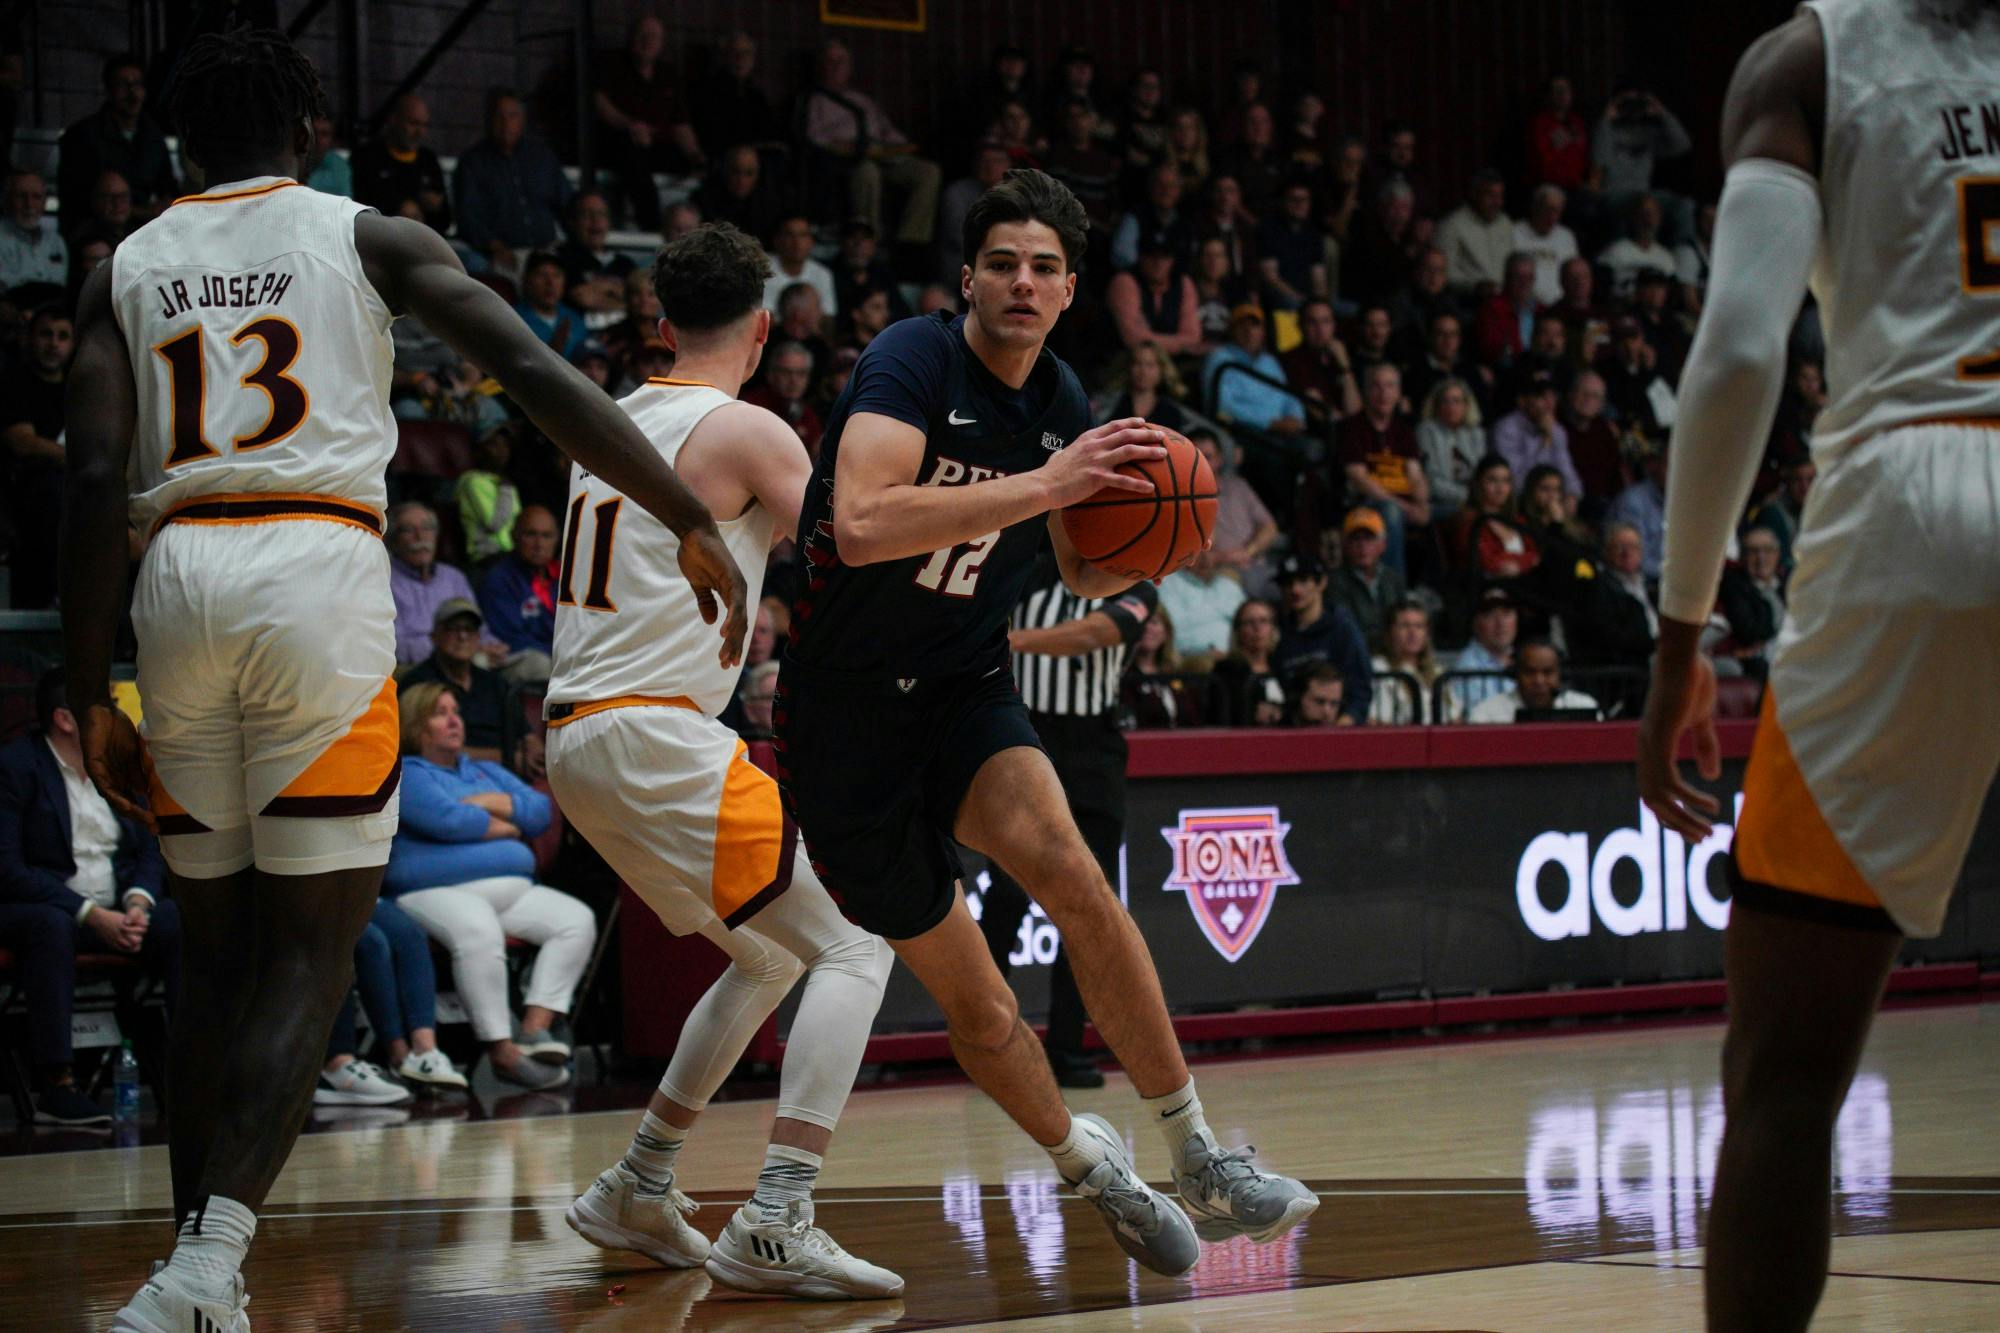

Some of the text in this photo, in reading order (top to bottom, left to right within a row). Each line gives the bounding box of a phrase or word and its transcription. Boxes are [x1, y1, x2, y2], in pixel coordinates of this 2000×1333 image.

[158, 273, 293, 319] JR JOSEPH
[153, 315, 310, 470] 13
[919, 452, 1010, 487] PE
[558, 491, 622, 612] 11
[1174, 832, 1289, 883] IONA
[1516, 791, 1745, 941] adid
[1203, 882, 1260, 899] GAELS
